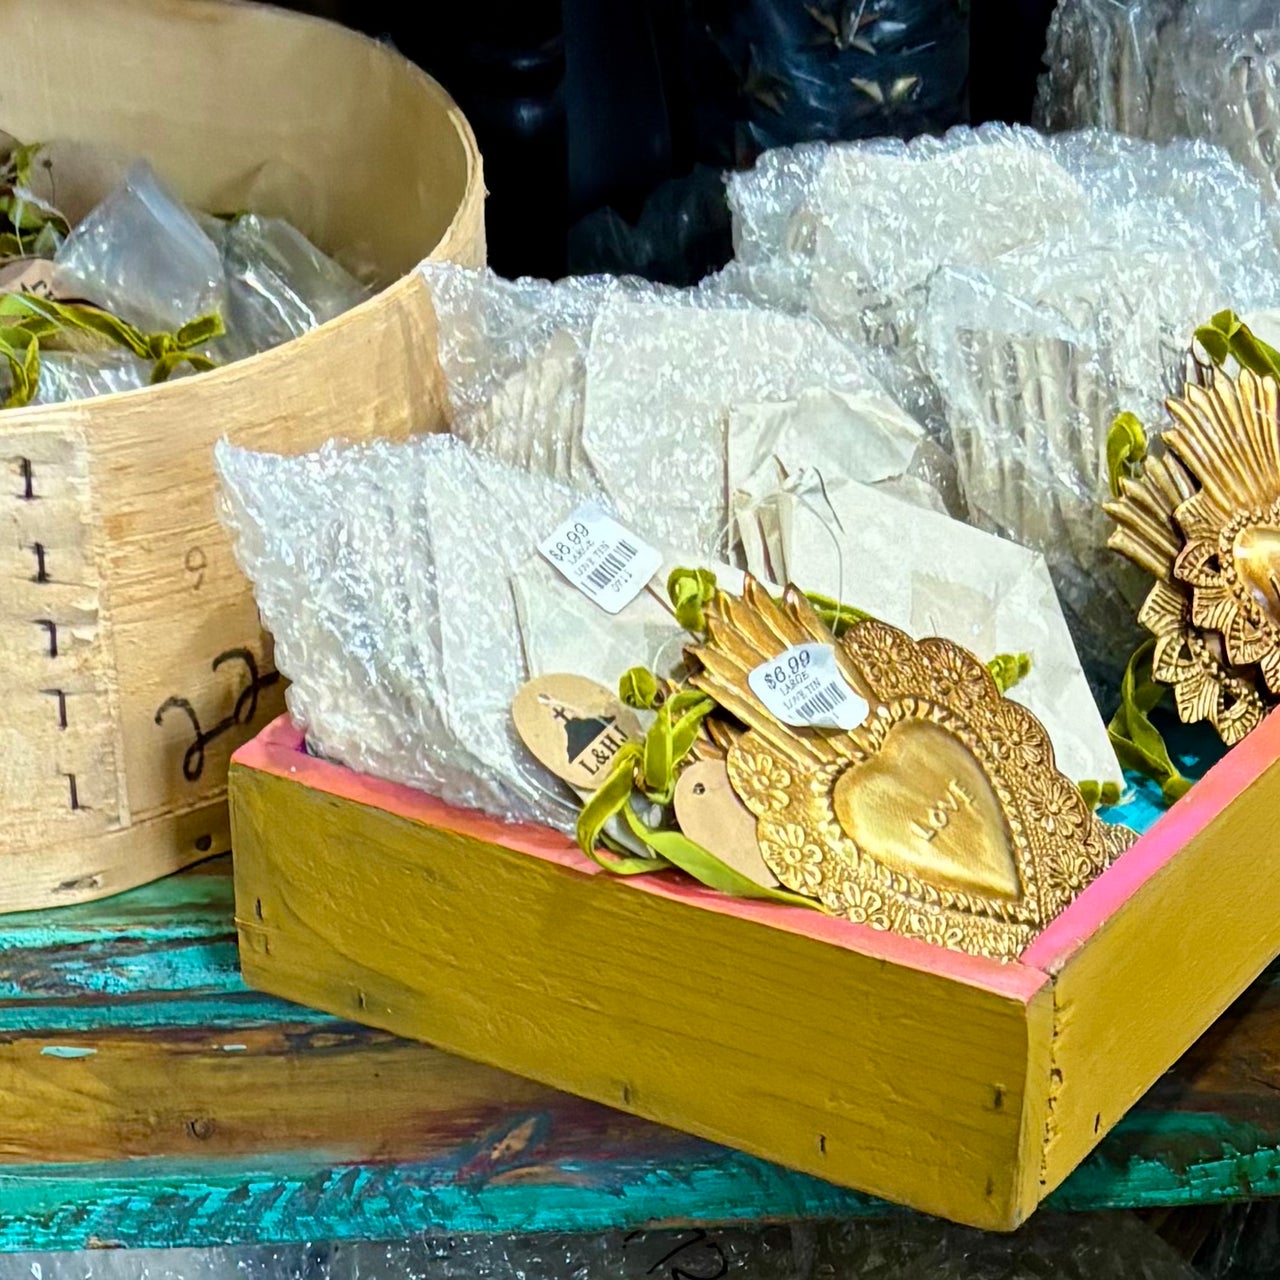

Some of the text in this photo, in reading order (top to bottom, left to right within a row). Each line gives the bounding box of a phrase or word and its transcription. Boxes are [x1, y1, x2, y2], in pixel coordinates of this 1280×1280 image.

[763, 649, 811, 691] $6.99
[577, 723, 629, 776] L&HJ
[909, 777, 977, 842] LOVE
